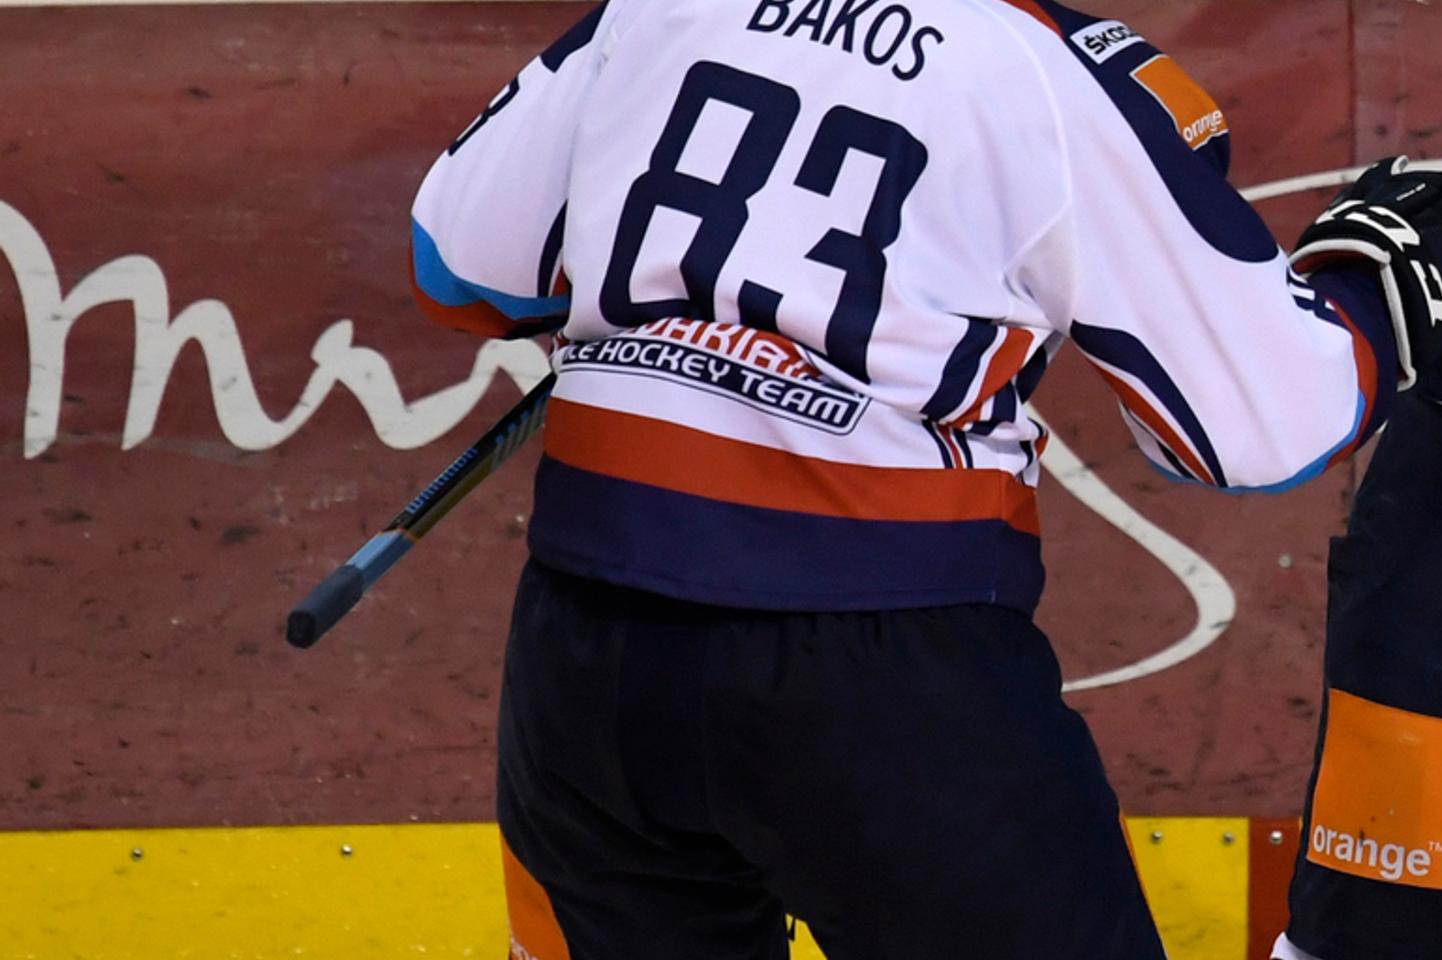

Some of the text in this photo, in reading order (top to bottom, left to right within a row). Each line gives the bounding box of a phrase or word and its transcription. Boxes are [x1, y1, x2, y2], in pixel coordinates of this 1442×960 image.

[598, 58, 930, 384] 83
[598, 340, 730, 383] HOCKEY
[740, 370, 851, 425] TEAM
